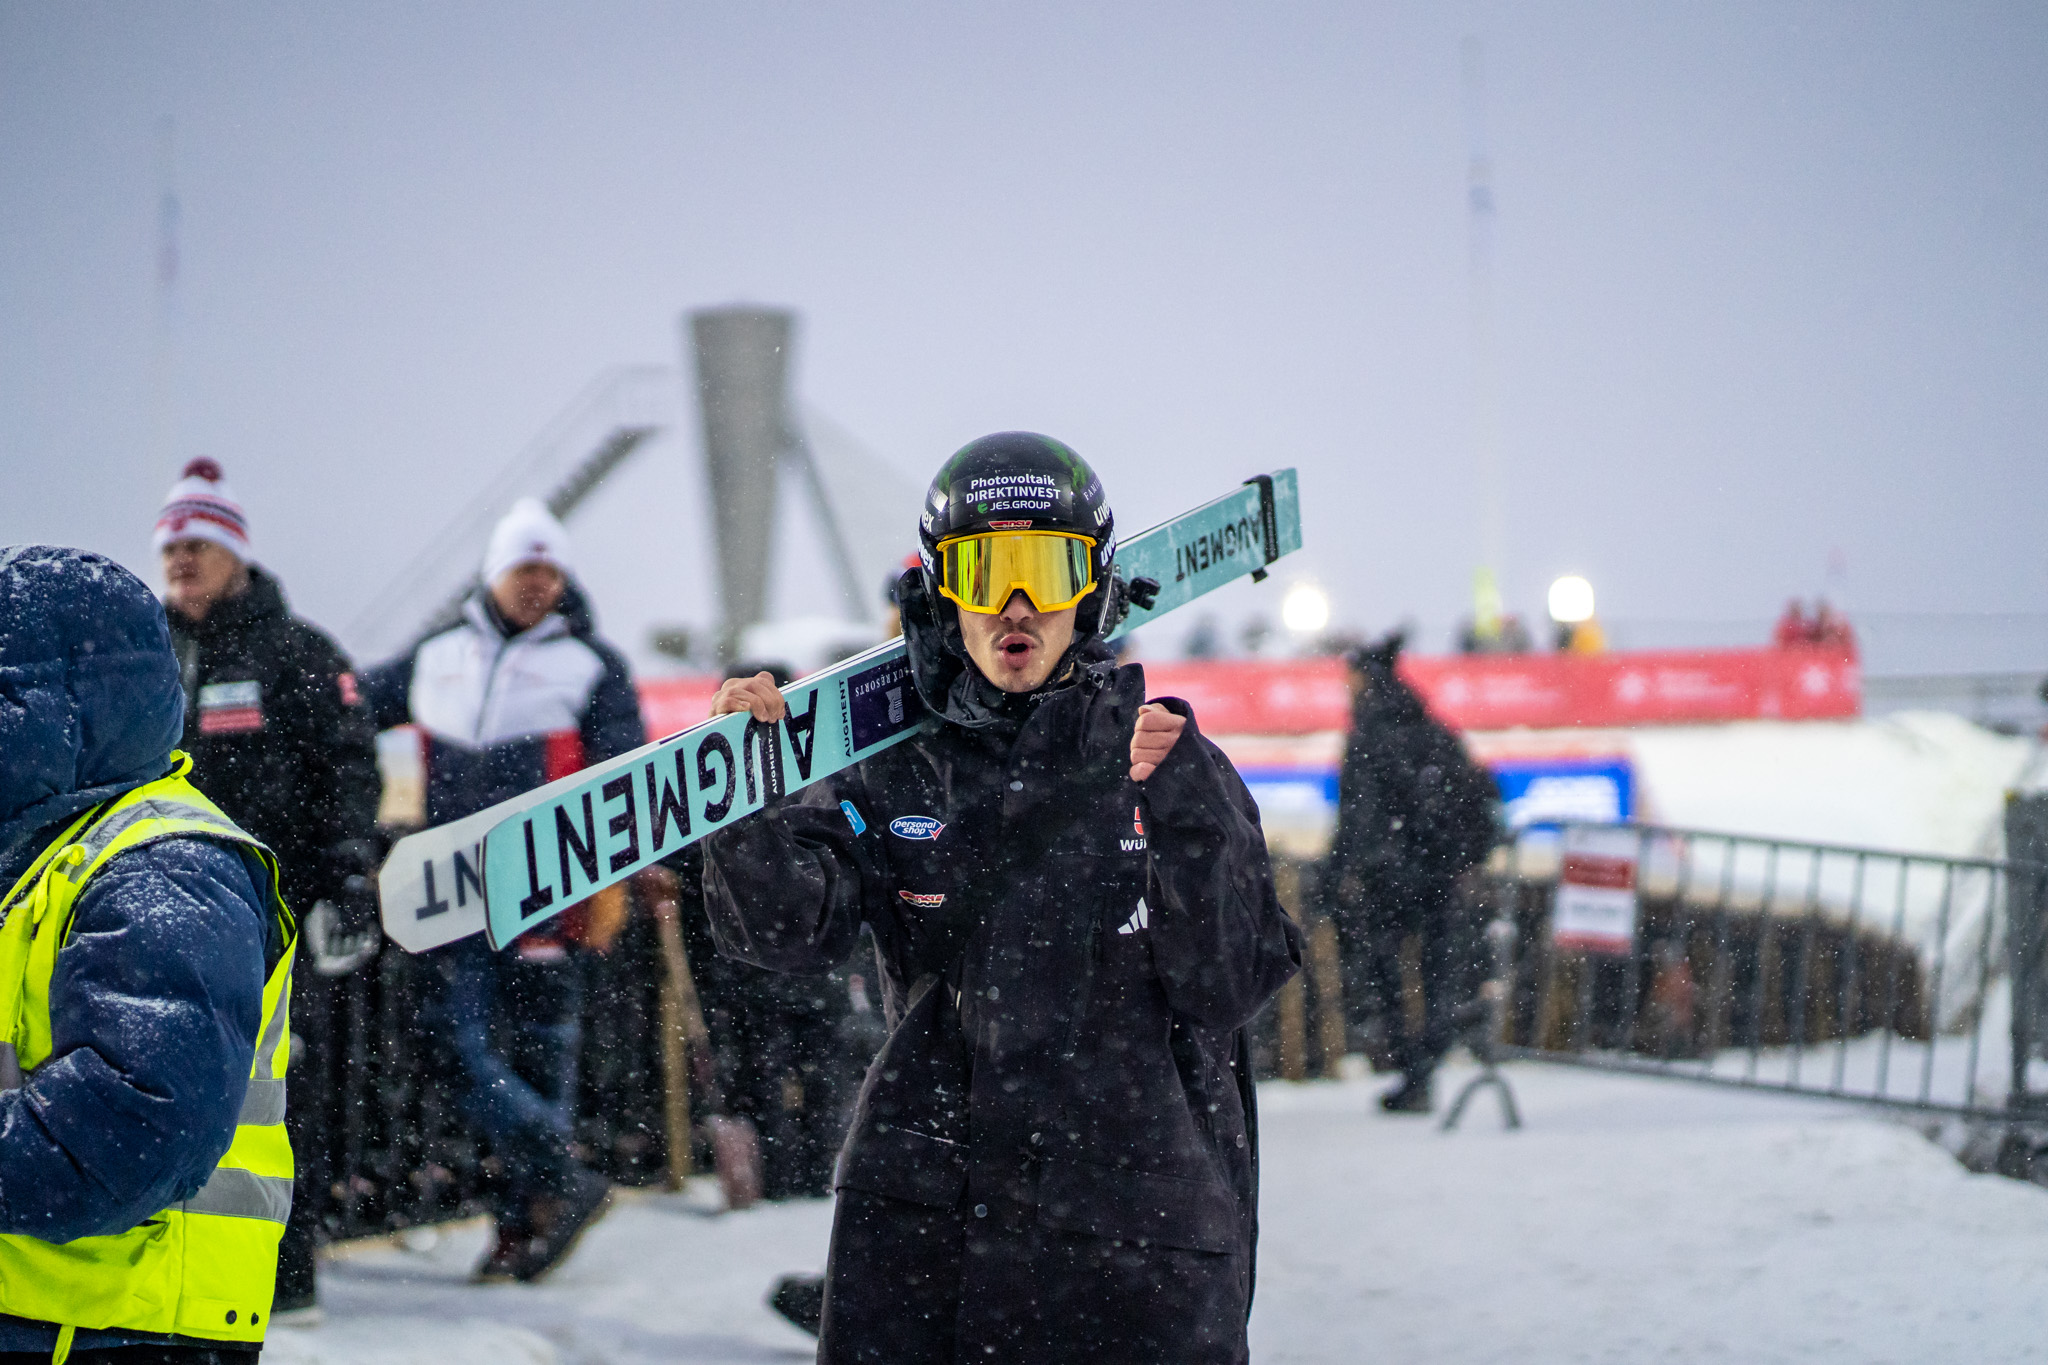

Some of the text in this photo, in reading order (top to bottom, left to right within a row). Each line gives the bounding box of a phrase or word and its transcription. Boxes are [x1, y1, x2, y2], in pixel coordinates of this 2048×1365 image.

[971, 474, 1056, 489] Photovoltaik
[966, 486, 1061, 504] DIREKTINVEST
[990, 500, 1051, 511] JES.GROUP
[1176, 510, 1263, 582] AUGMENT
[855, 673, 891, 697] RESORTS
[839, 680, 852, 757] AUGMENT
[894, 821, 937, 829] personal
[902, 826, 926, 836] shop
[916, 894, 945, 907] DSV
